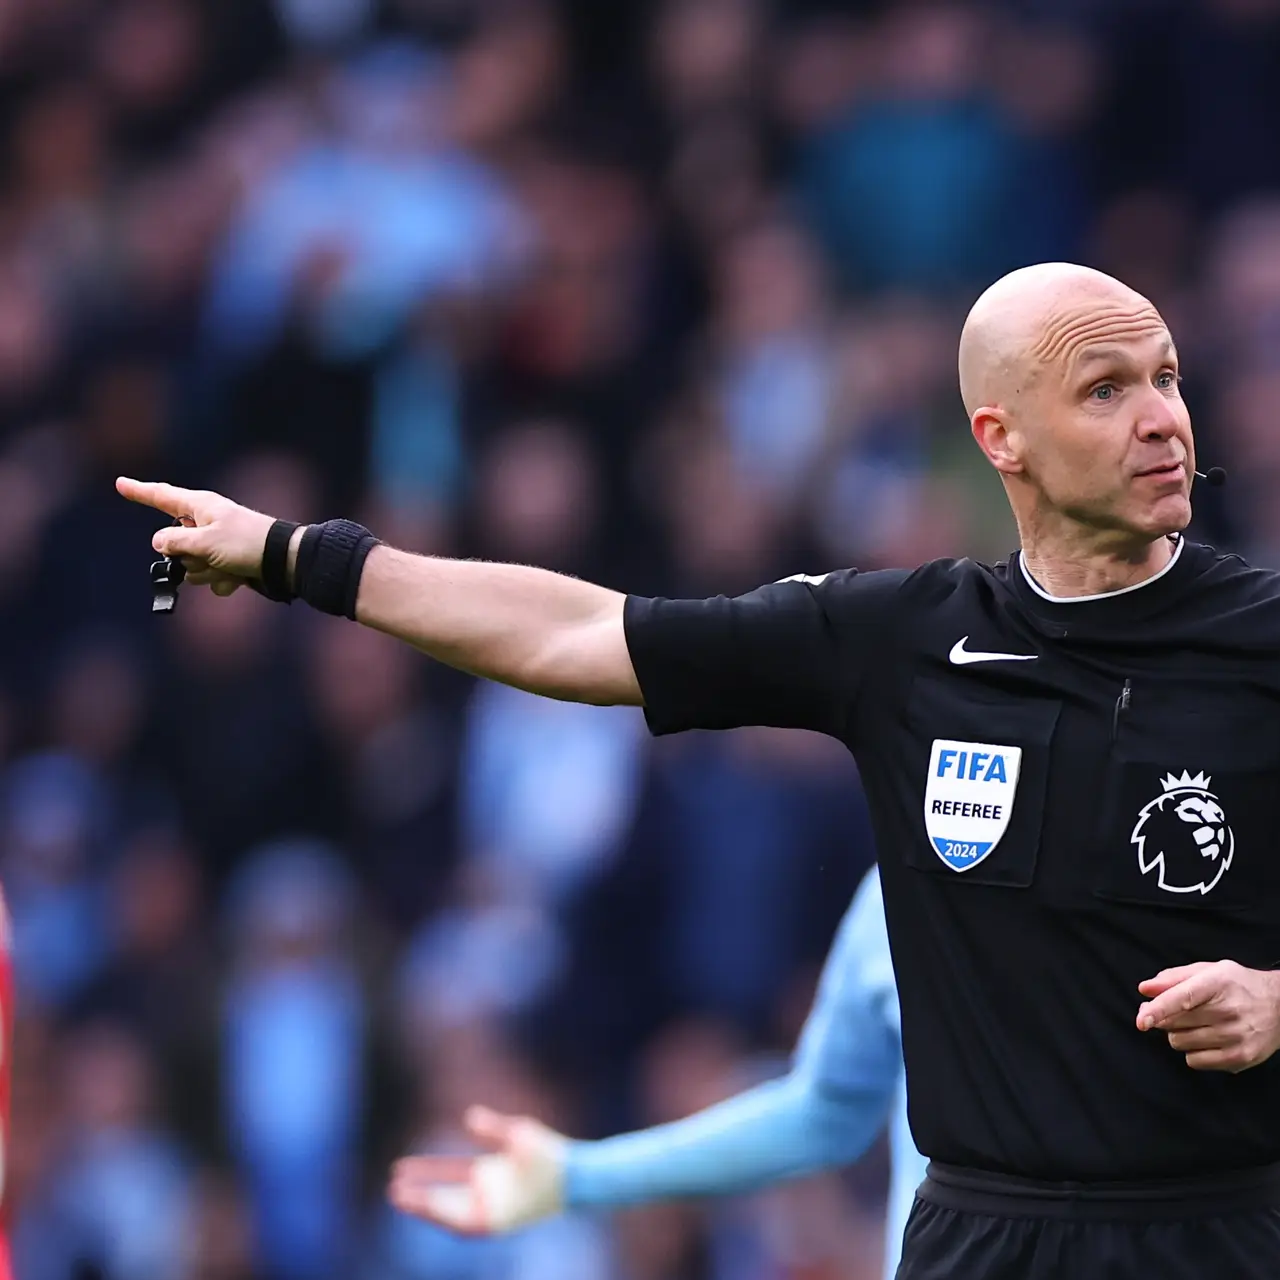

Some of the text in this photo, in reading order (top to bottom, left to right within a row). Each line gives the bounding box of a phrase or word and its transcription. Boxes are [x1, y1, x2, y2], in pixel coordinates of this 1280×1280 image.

[936, 748, 1008, 784] FIFA
[931, 799, 1003, 820] REFEREE
[944, 842, 978, 859] 2024
